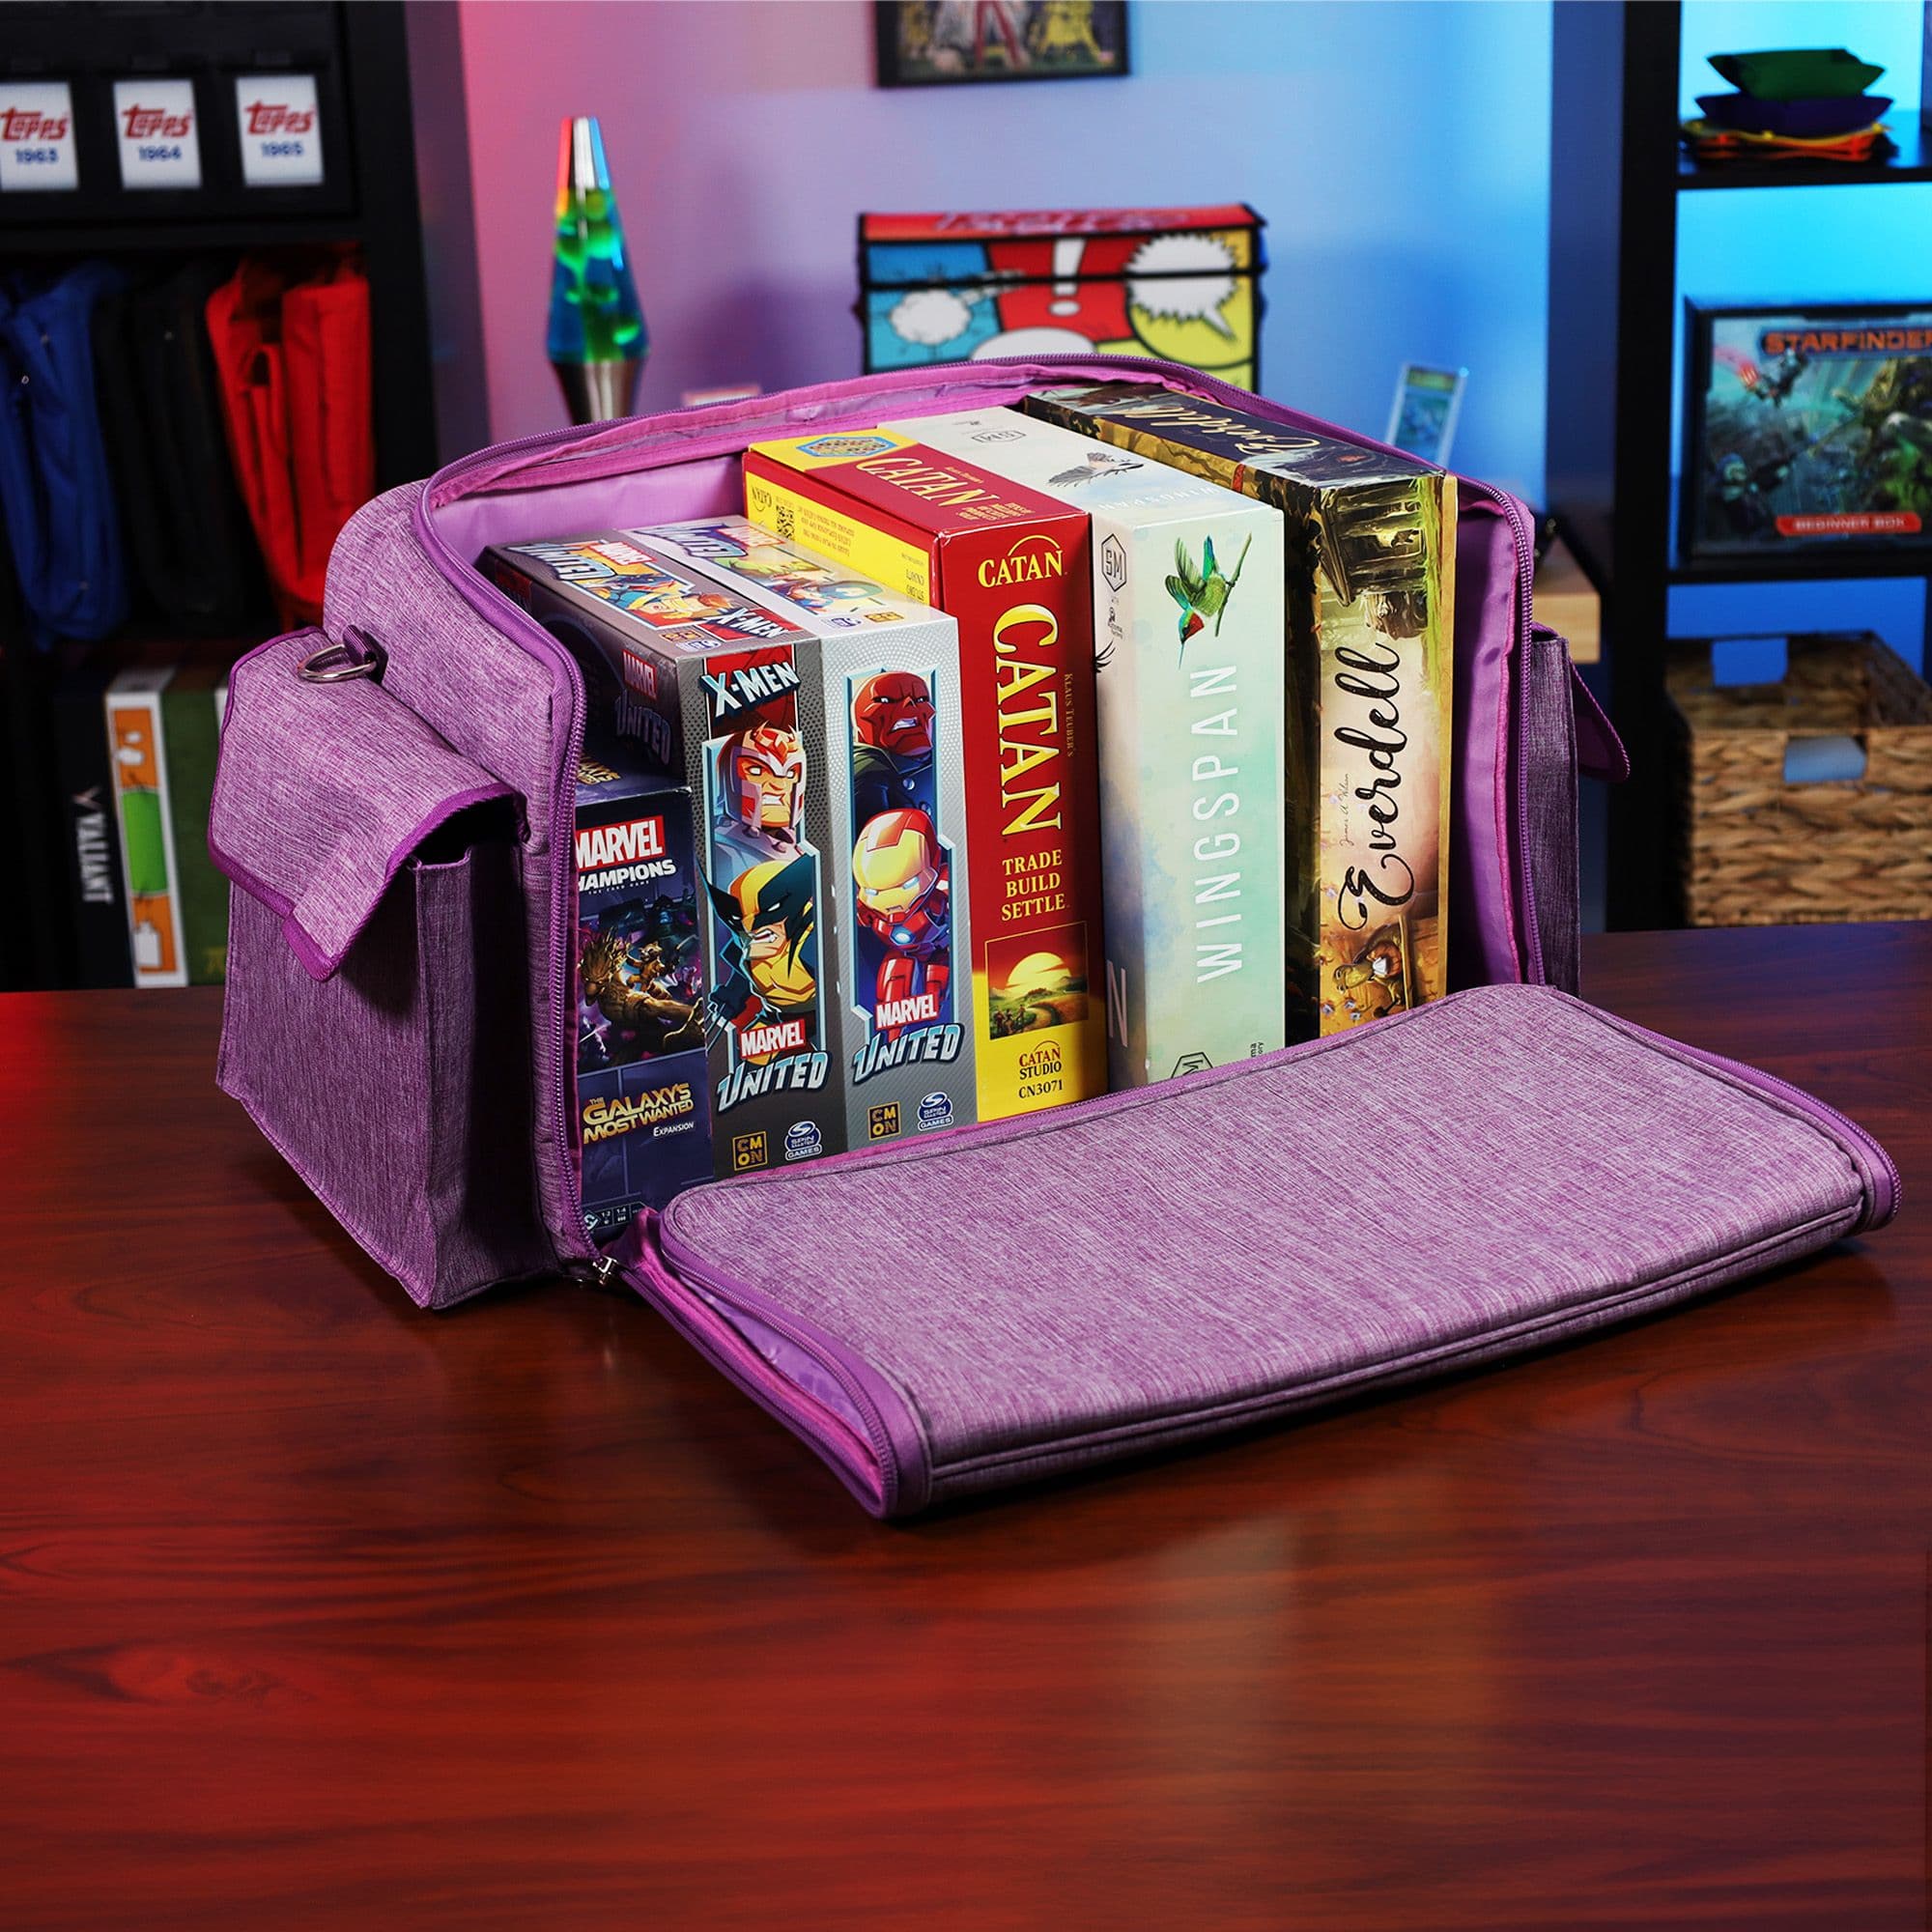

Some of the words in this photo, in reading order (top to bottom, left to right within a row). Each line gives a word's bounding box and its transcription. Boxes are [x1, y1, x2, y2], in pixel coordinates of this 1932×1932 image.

[122, 103, 190, 139] Topps
[244, 100, 315, 135] Topps
[15, 147, 59, 164] 1963
[138, 146, 183, 162] 1964
[260, 141, 303, 157] 1965
[857, 457, 1001, 508] CATAN
[978, 550, 1064, 588] CATAN
[622, 651, 658, 699] MARVEL
[701, 662, 801, 718] X-MEN
[614, 689, 671, 766] UNITED
[992, 603, 1062, 837] CATAN
[1334, 641, 1414, 930] Everdell
[1189, 665, 1243, 984] WINGSPAN
[576, 819, 664, 869] MARVEL
[579, 859, 677, 893] HAMPIONS
[1003, 849, 1063, 876] TRADE
[1006, 872, 1061, 898] BUILD
[1002, 894, 1065, 922] SETTLE
[877, 994, 937, 1029] MARVEL
[741, 1022, 804, 1057] MARVEL
[854, 1024, 961, 1083] UNITED
[1019, 1047, 1061, 1067] CATAN
[717, 1052, 829, 1112] UNITED
[1019, 1061, 1062, 1080] STUDIO
[582, 1082, 692, 1125] GALAXY'S
[1018, 1080, 1064, 1099] CN3071
[582, 1115, 641, 1145] MOST
[640, 1099, 695, 1125] WANTED
[920, 1118, 952, 1128] GAMES
[923, 1105, 947, 1115] SPIN
[787, 1147, 819, 1157] GAMES
[791, 1135, 814, 1145] SPIN
